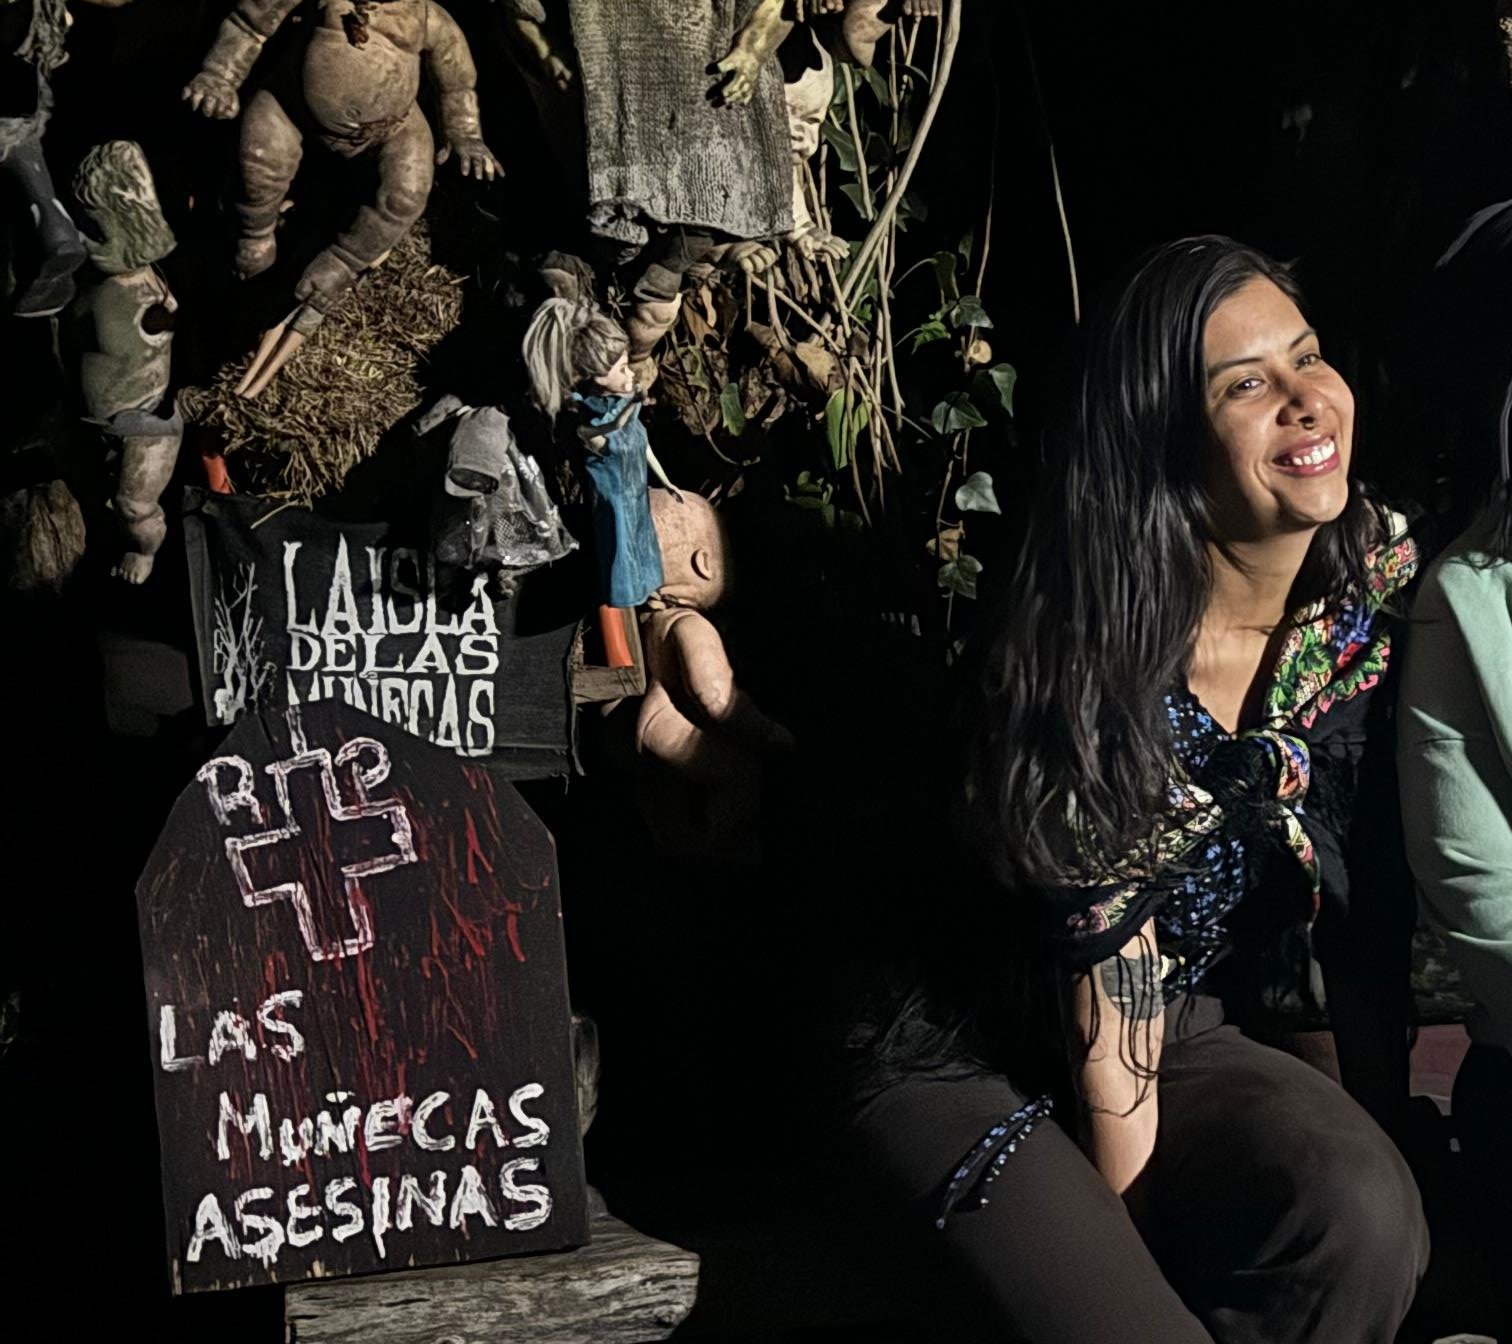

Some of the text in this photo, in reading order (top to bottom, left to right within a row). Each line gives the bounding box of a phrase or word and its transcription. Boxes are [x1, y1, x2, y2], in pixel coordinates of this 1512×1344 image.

[283, 532, 363, 636] LA
[286, 632, 500, 675] DE LAS
[160, 990, 303, 1072] LAS
[186, 1158, 554, 1266] ASESINAS
